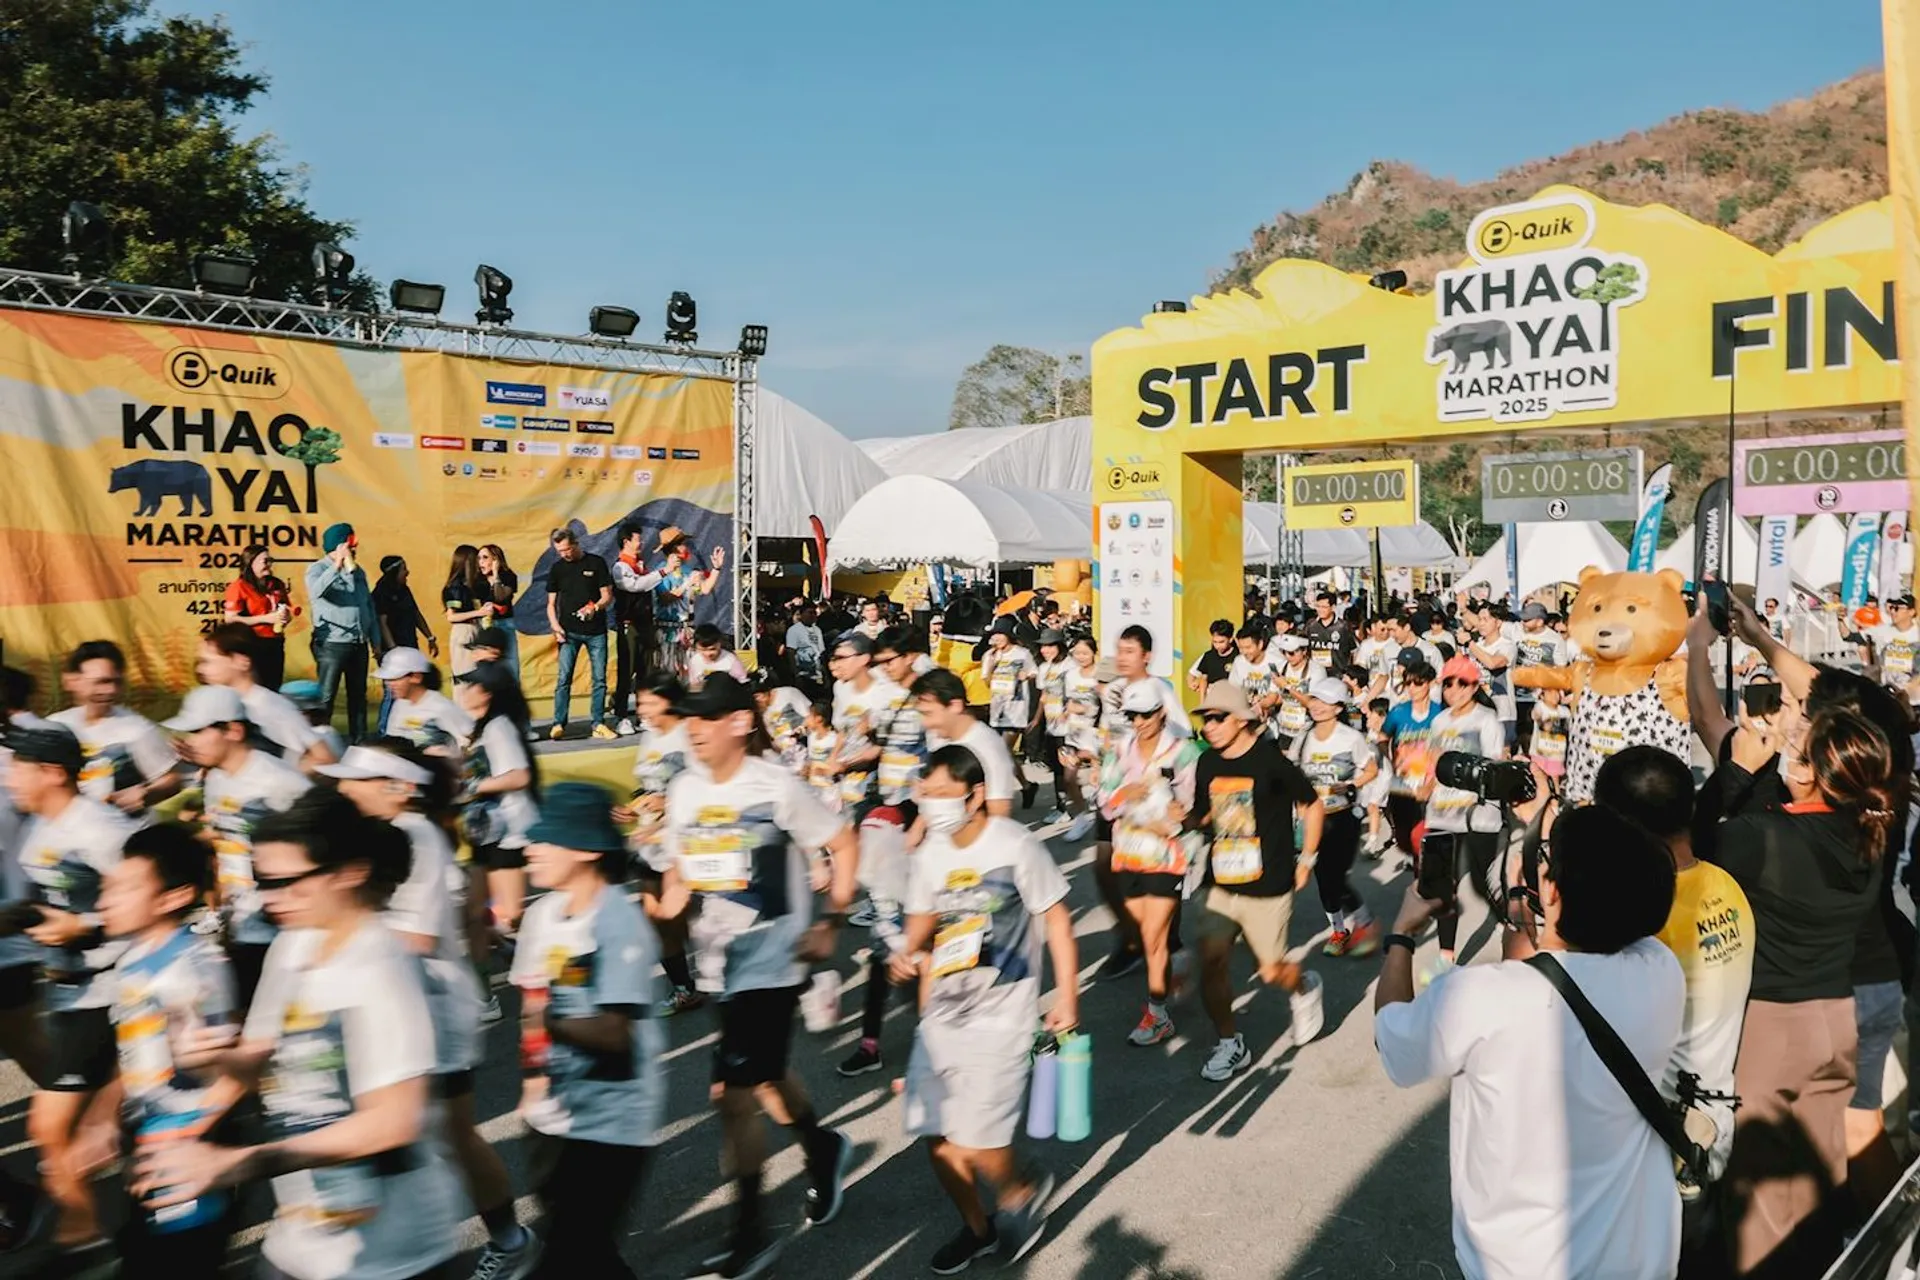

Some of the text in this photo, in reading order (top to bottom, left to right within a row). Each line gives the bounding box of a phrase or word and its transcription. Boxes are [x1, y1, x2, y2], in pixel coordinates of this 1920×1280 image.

[1481, 217, 1575, 254] B-Quik
[1442, 256, 1607, 317] KHAO
[1516, 303, 1611, 360] YAI
[171, 351, 278, 388] B-Quik
[1136, 343, 1367, 429] START
[1444, 363, 1610, 401] MARATHON
[574, 396, 608, 406] YUASA
[1499, 397, 1549, 416] 2025
[121, 403, 314, 457] KHAO
[216, 464, 319, 514] YAI
[1295, 470, 1406, 504] 0:00:00
[1497, 461, 1624, 494] 0:00:08
[126, 522, 319, 548] MARATHON
[1704, 506, 1719, 573] YOKOHAMA
[199, 552, 241, 569] 202
[1696, 908, 1735, 935] KHAO
[1720, 921, 1741, 944] YAI
